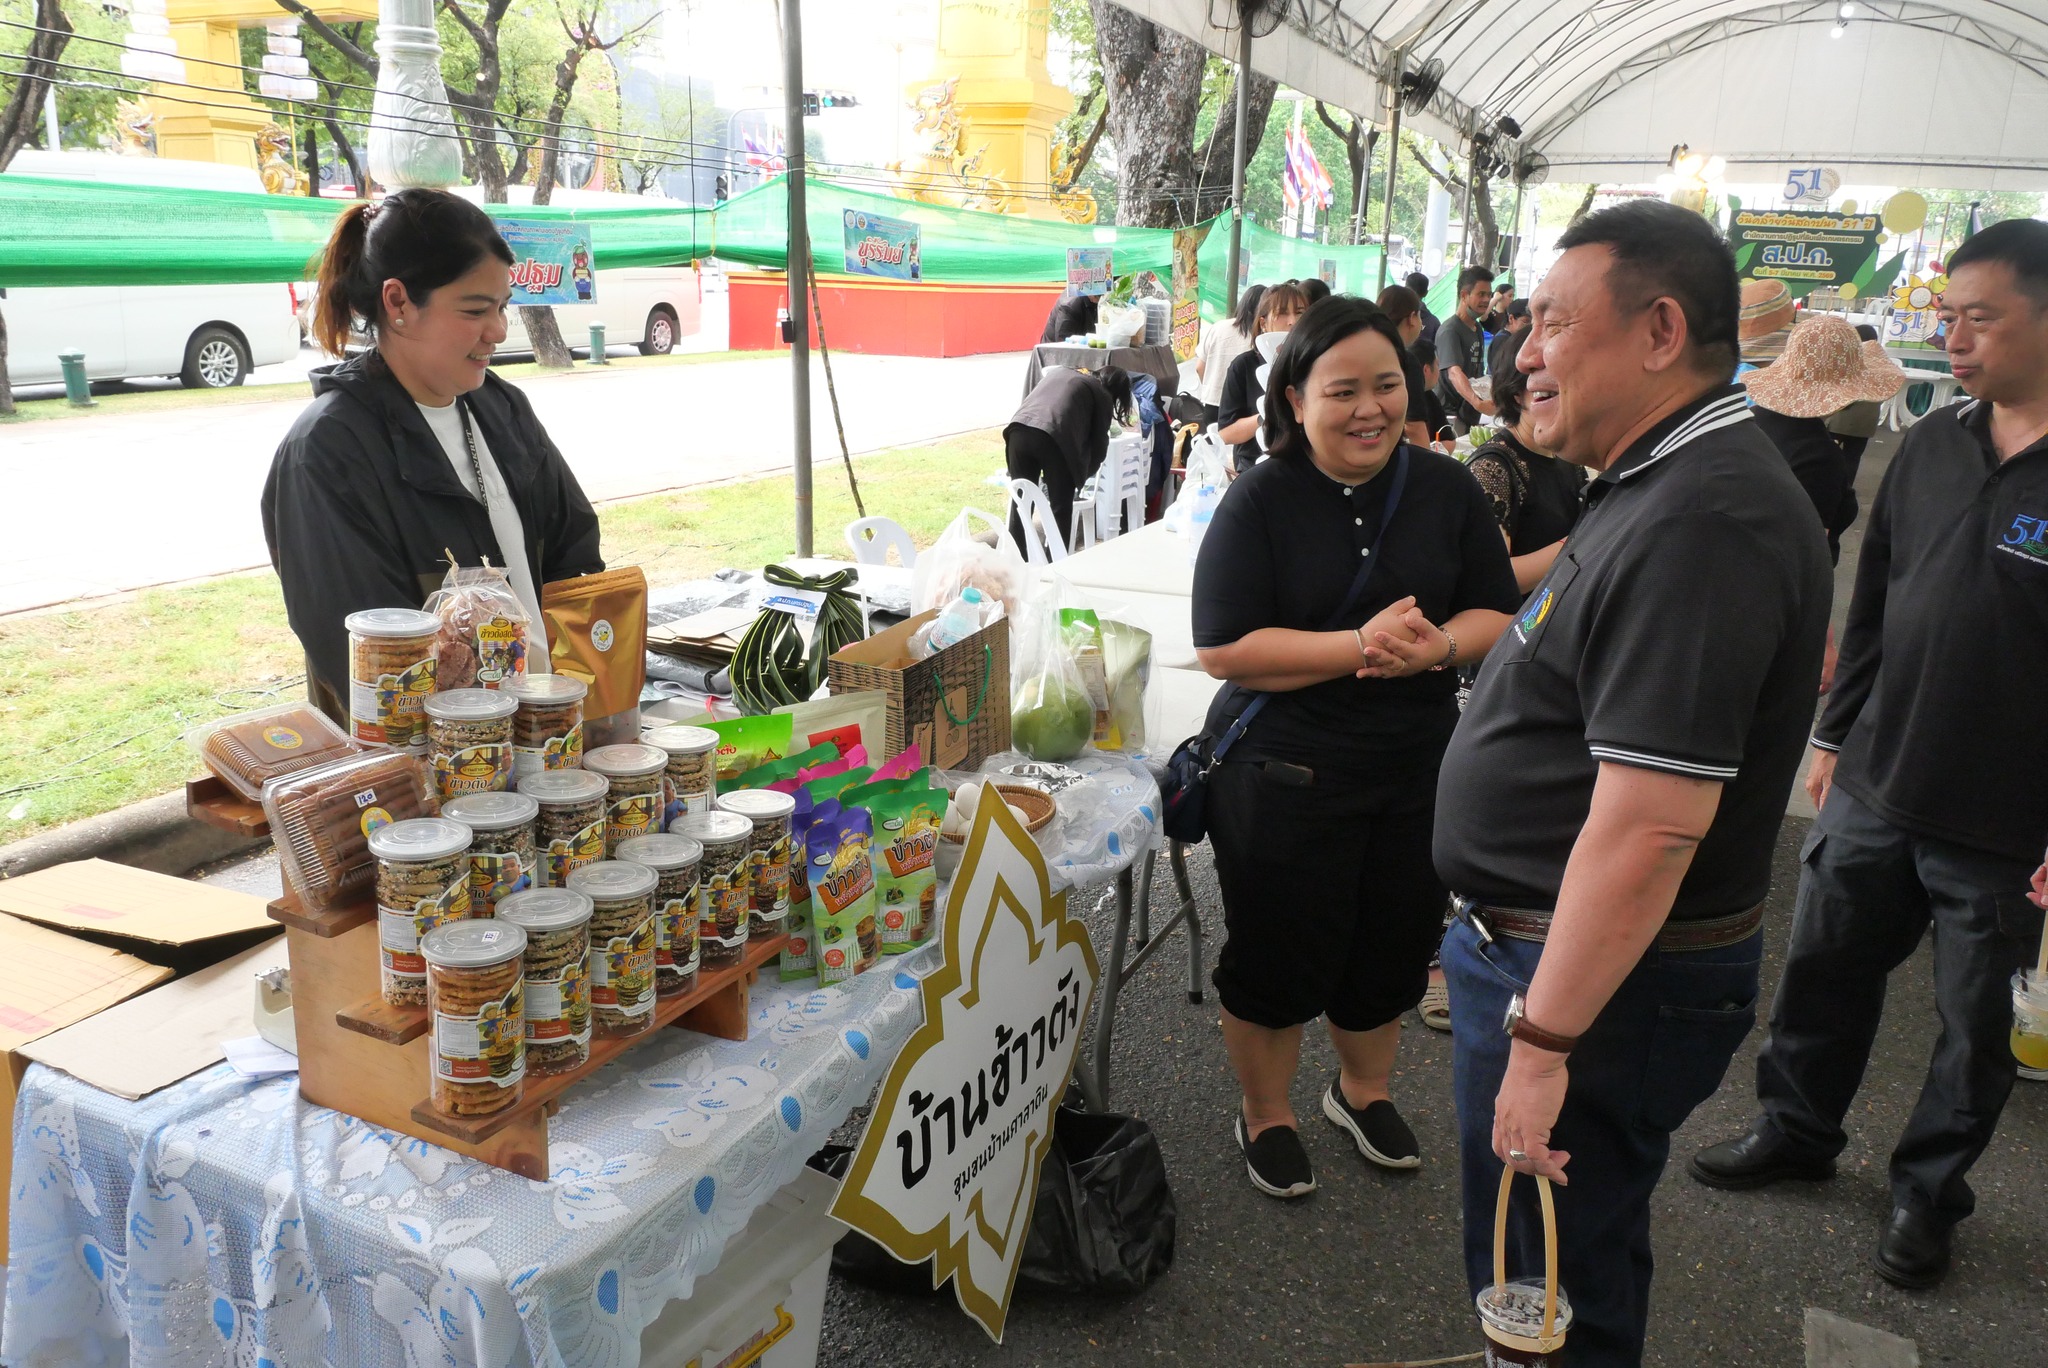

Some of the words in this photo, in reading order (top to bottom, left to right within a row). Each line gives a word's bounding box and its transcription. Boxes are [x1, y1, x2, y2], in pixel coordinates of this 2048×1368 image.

[1783, 168, 1822, 200] 51
[1841, 219, 1857, 229] 51
[1763, 244, 1833, 265] ส.ป.ก.
[508, 257, 563, 293] รปฐม
[1889, 311, 1922, 337] 51
[397, 691, 432, 707] ข้าวตั
[449, 776, 488, 790] ข้าวตัง
[358, 793, 373, 805] 120
[891, 828, 934, 862] ข้าวตั
[825, 853, 871, 898] ข้าวตัง
[896, 967, 1080, 1190] บ้านข้าวตัง
[954, 1083, 1048, 1202] ชุมชนบ้านศาลาดิน
